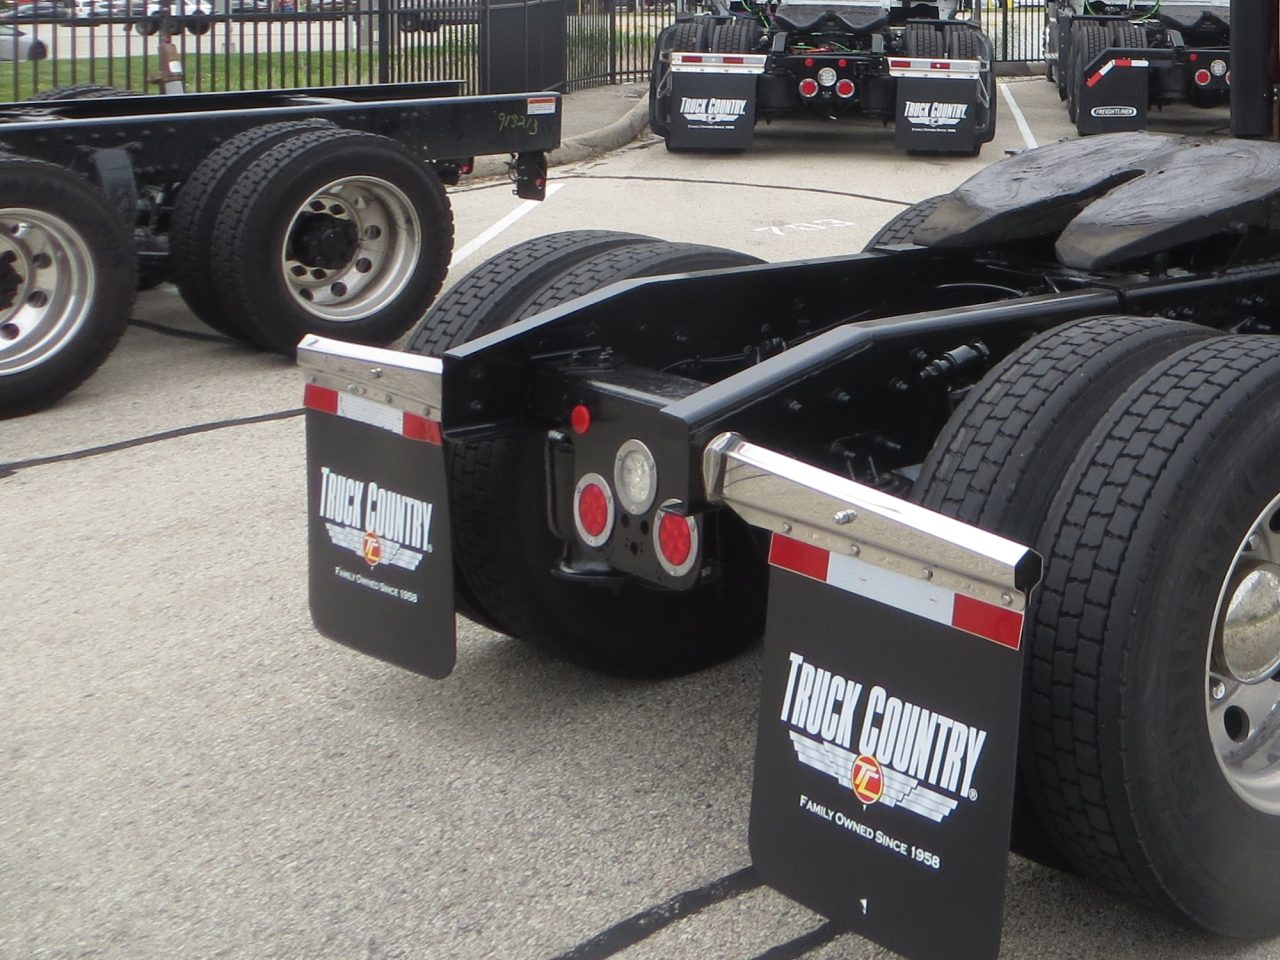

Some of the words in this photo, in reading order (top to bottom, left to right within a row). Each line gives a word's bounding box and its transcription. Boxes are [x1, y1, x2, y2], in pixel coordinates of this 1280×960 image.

[680, 97, 708, 113] TRUCK
[708, 98, 747, 115] COUNTRY
[904, 101, 931, 117] TRUCK
[931, 102, 968, 118] COUNTRY
[319, 466, 364, 528] TRUCK
[365, 482, 432, 551] COUNTRY
[780, 651, 863, 748] TRUCK
[858, 685, 987, 798] COUNTRY
[800, 794, 835, 820] FAMILY
[835, 812, 874, 840] OWNED
[875, 830, 908, 855] SINCE
[911, 846, 940, 869] 1958
